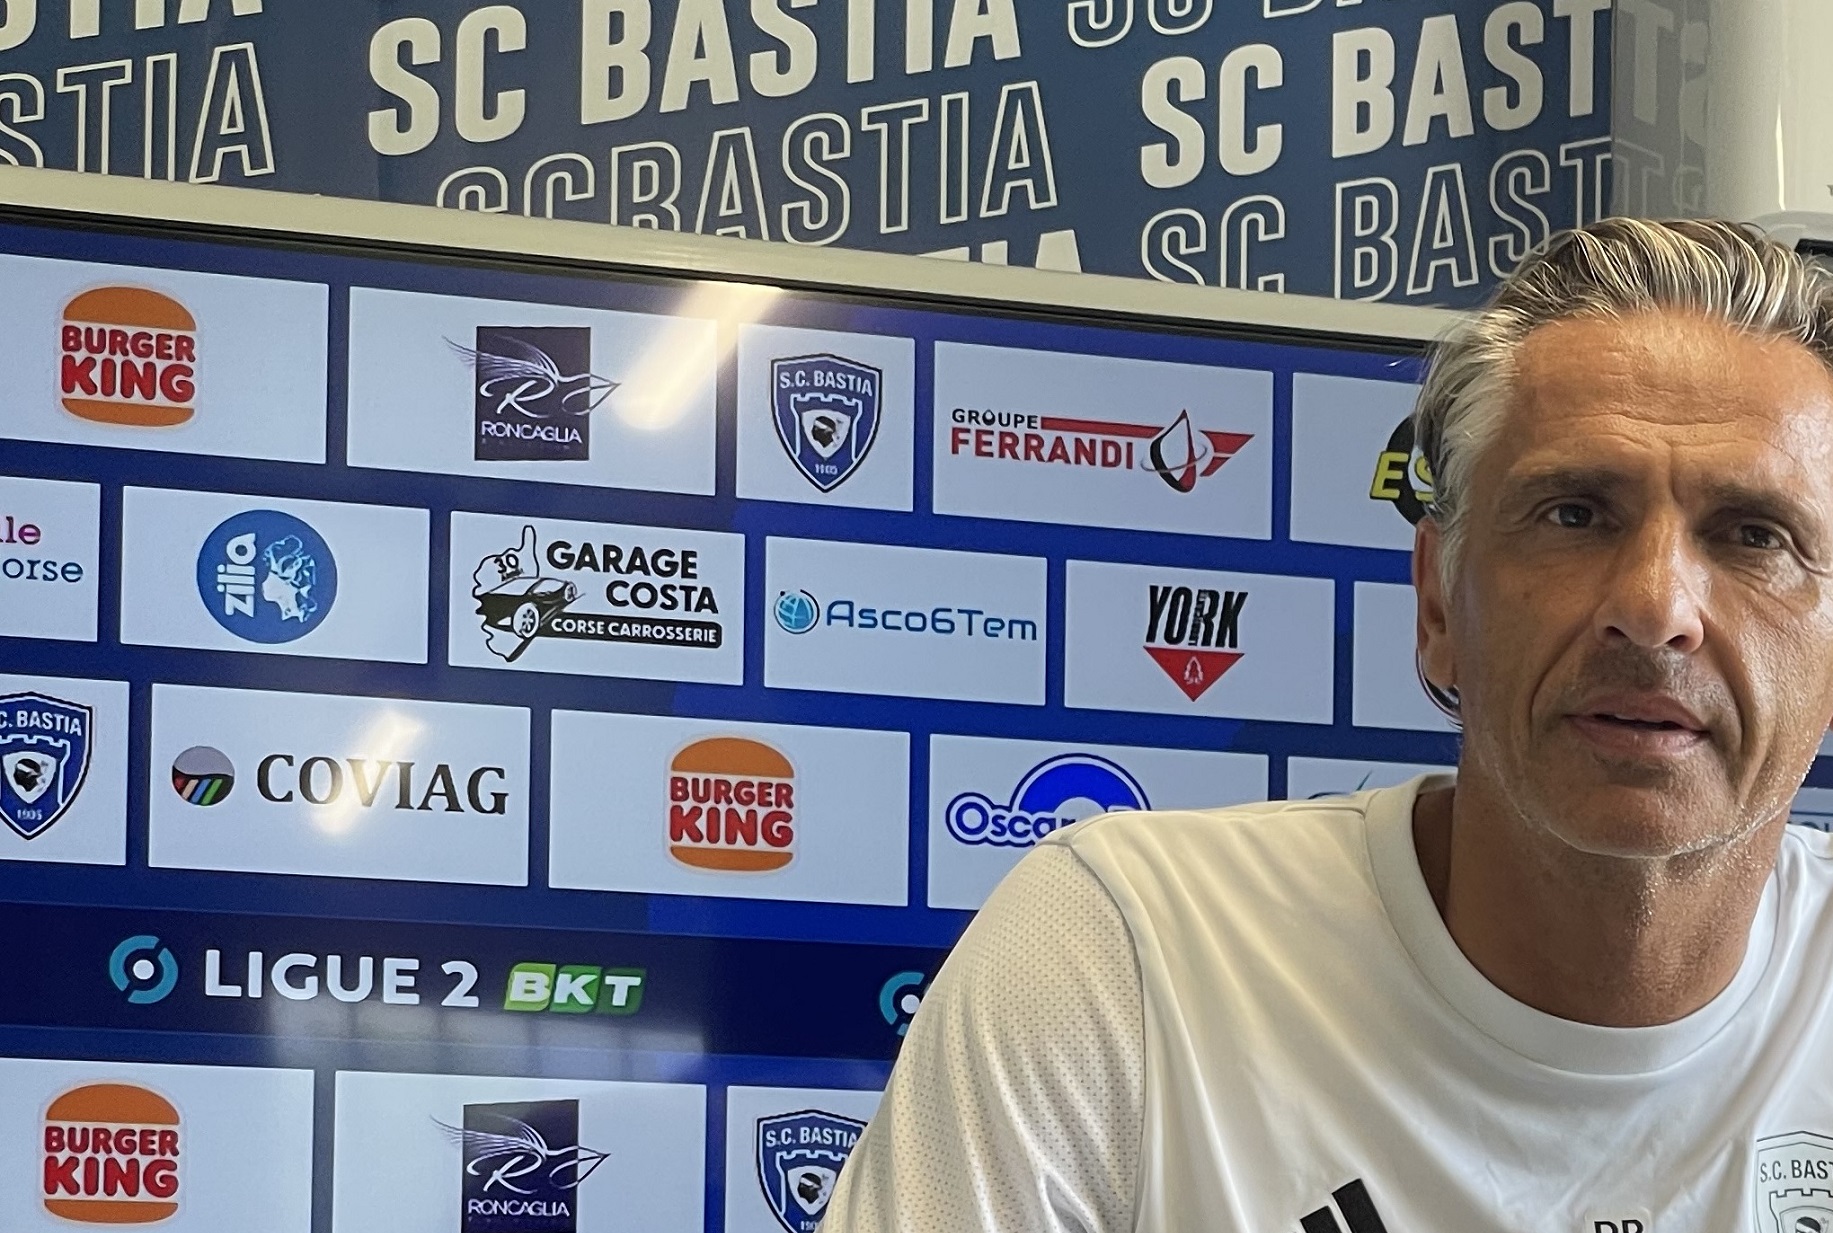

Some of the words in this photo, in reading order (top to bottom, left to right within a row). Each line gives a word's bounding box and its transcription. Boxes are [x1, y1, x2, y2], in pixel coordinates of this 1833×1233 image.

[367, 5, 527, 156] SC
[1140, 42, 1284, 190] SC
[1332, 0, 1608, 159] BAST
[0, 42, 274, 184] STIA
[1336, 135, 1612, 300] BAST
[61, 324, 195, 364] BURGER
[61, 354, 195, 402] KING
[813, 369, 873, 397] BASTIA
[481, 420, 583, 444] RONCAGLIA
[951, 408, 1039, 430] GROUPE
[951, 427, 1135, 470] FERRANDI
[2, 558, 84, 583] orse
[224, 532, 258, 619] zilia
[546, 540, 699, 580] GARAGE
[606, 579, 719, 615] COSTA
[1145, 585, 1249, 649] YORK
[551, 617, 605, 636] CORSE
[608, 620, 718, 644] CARROSSERIE
[825, 599, 1038, 643] Asco6Tem
[17, 710, 82, 737] BASTIA
[256, 753, 511, 817] COVIAG
[670, 776, 794, 809] BURGER
[669, 803, 794, 848] KING
[954, 800, 1072, 838] Osca
[204, 948, 421, 1005] LIGUE
[440, 960, 481, 1008] 2
[506, 967, 643, 1008] BKT
[44, 1125, 180, 1157] BURGER
[765, 1128, 796, 1149] S.C.
[43, 1154, 179, 1199] KING
[1760, 1160, 1787, 1184] S.C.
[467, 1198, 570, 1217] RONCAGLIA
